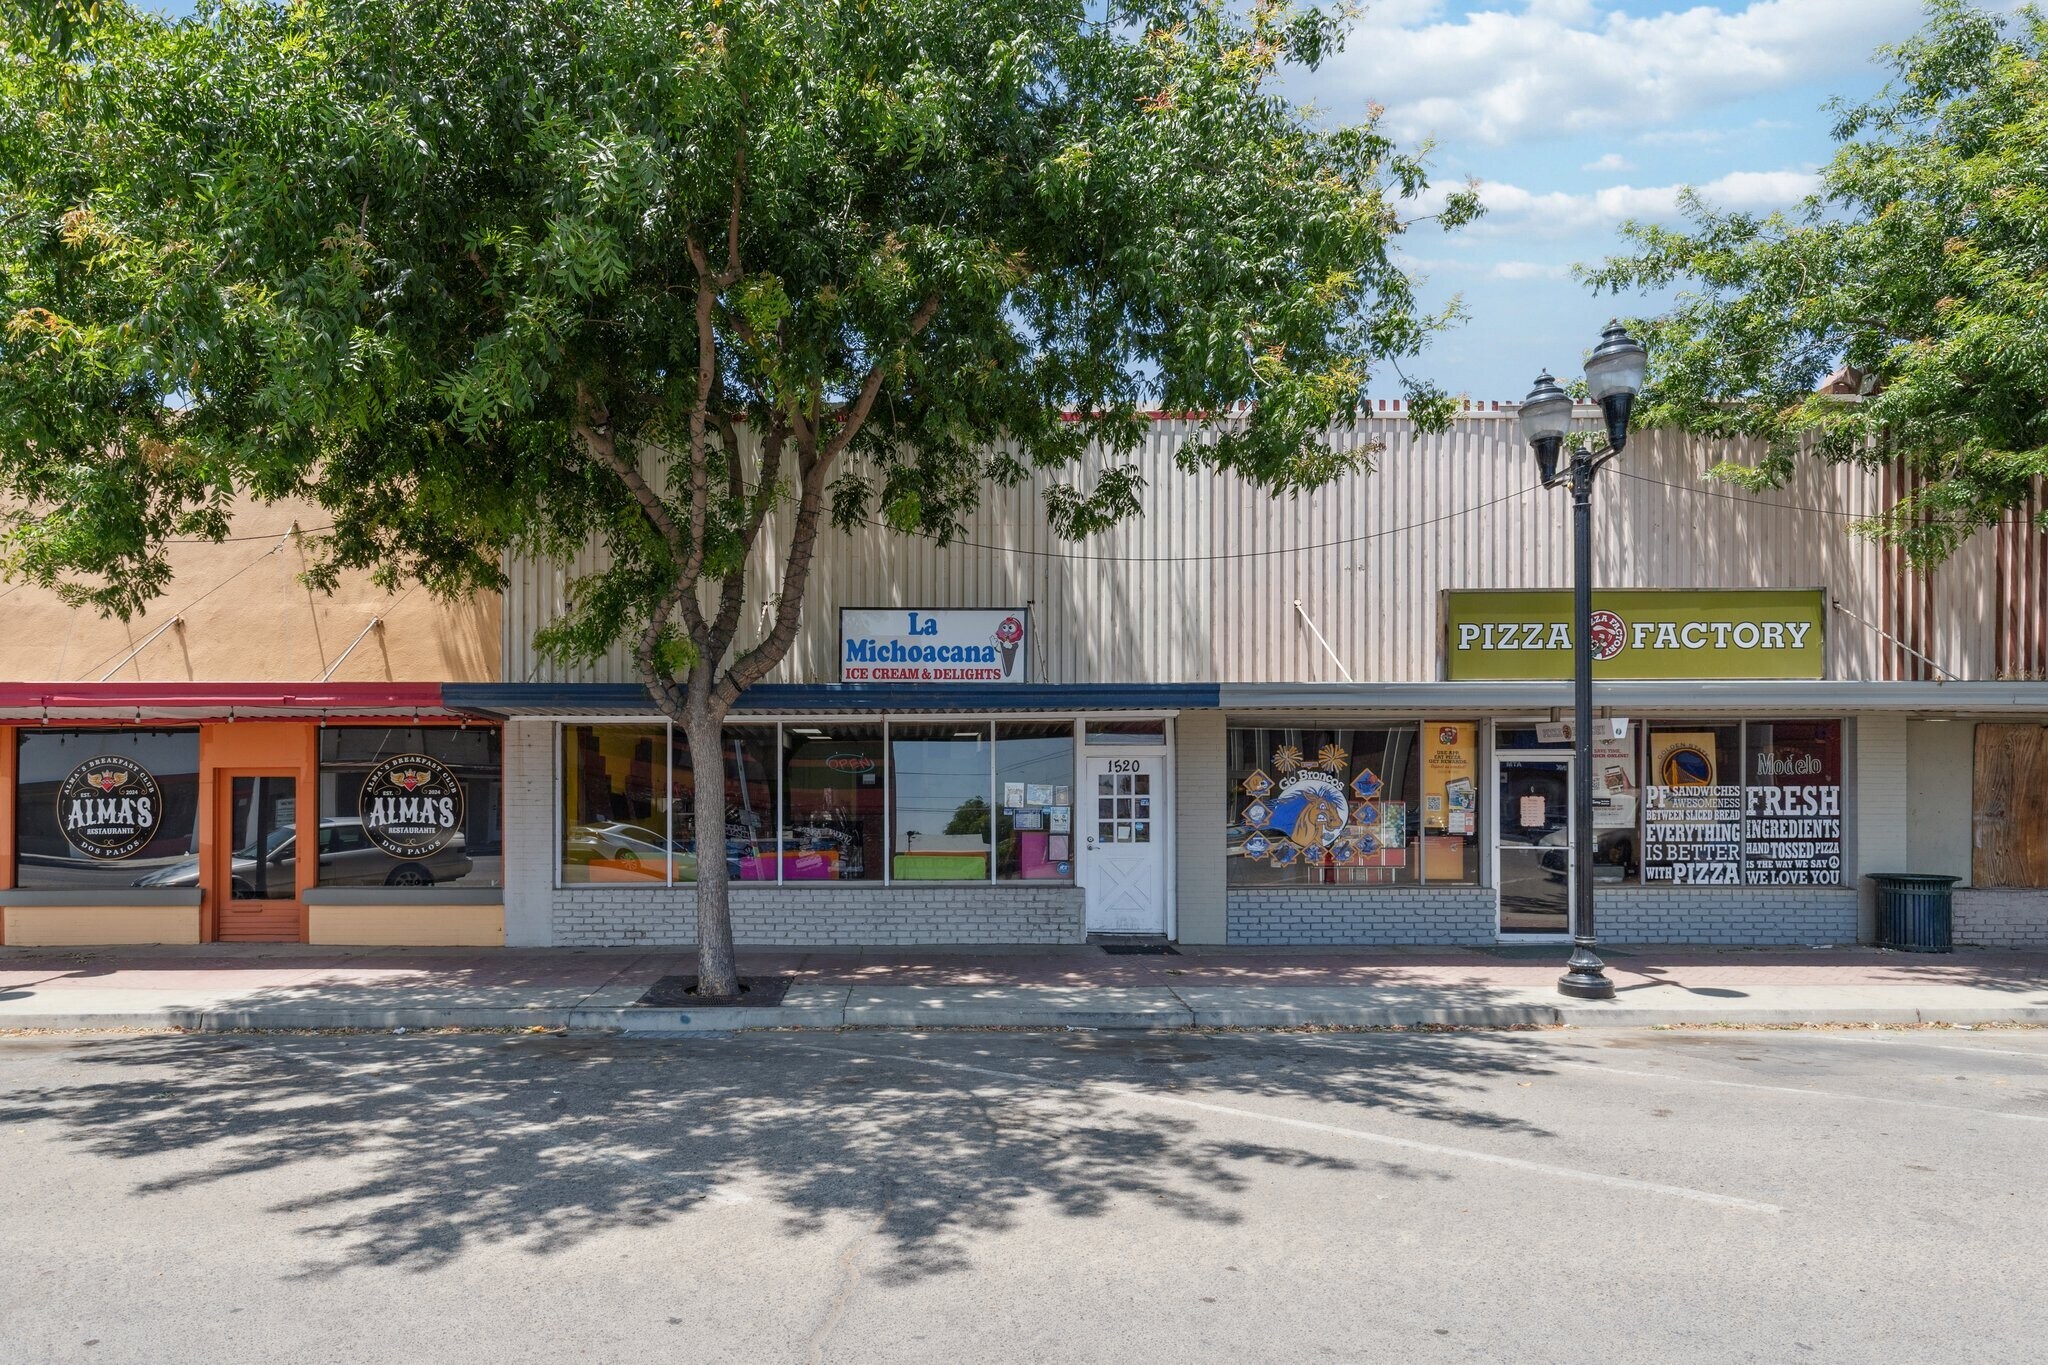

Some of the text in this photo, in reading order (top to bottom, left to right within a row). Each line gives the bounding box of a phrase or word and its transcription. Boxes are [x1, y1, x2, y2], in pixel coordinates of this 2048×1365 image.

[908, 612, 938, 636] La
[1457, 622, 1811, 650] PIZZA FACTORY
[1609, 618, 1623, 655] FACTORY
[846, 639, 996, 663] Michoacana
[845, 668, 1001, 680] ICE CREAM & DELIGHTS
[1657, 742, 1686, 760] GOLDEN
[829, 757, 871, 769] OPEN
[1108, 759, 1140, 773] 1520
[1757, 753, 1822, 775] Modelo
[89, 758, 139, 772] BREAKFAST
[139, 772, 155, 794] CLUB
[392, 757, 442, 772] BREAKFAST
[442, 772, 457, 794] CLUB
[1278, 769, 1345, 791] Go Broncos
[1646, 786, 1740, 808] PF SANDWICHES
[1672, 798, 1740, 808] AWESOMENESS
[1745, 785, 1840, 816] FRESH
[1646, 810, 1740, 821] BETWEEN SLICED BREAD
[1646, 824, 1740, 842] EVERYTHING
[1746, 819, 1840, 839] INGREDIENTS
[81, 840, 139, 856] DOS PALOS
[382, 840, 441, 855] DOS PALOS
[1646, 844, 1740, 860] IS BETTER
[1746, 842, 1840, 859] HAND TOSSED PIZZA
[1646, 863, 1740, 884] WITH PIZZA
[1746, 860, 1828, 869] IS THE WAY WE SAY
[1746, 870, 1840, 885] WE LOVE YOU
